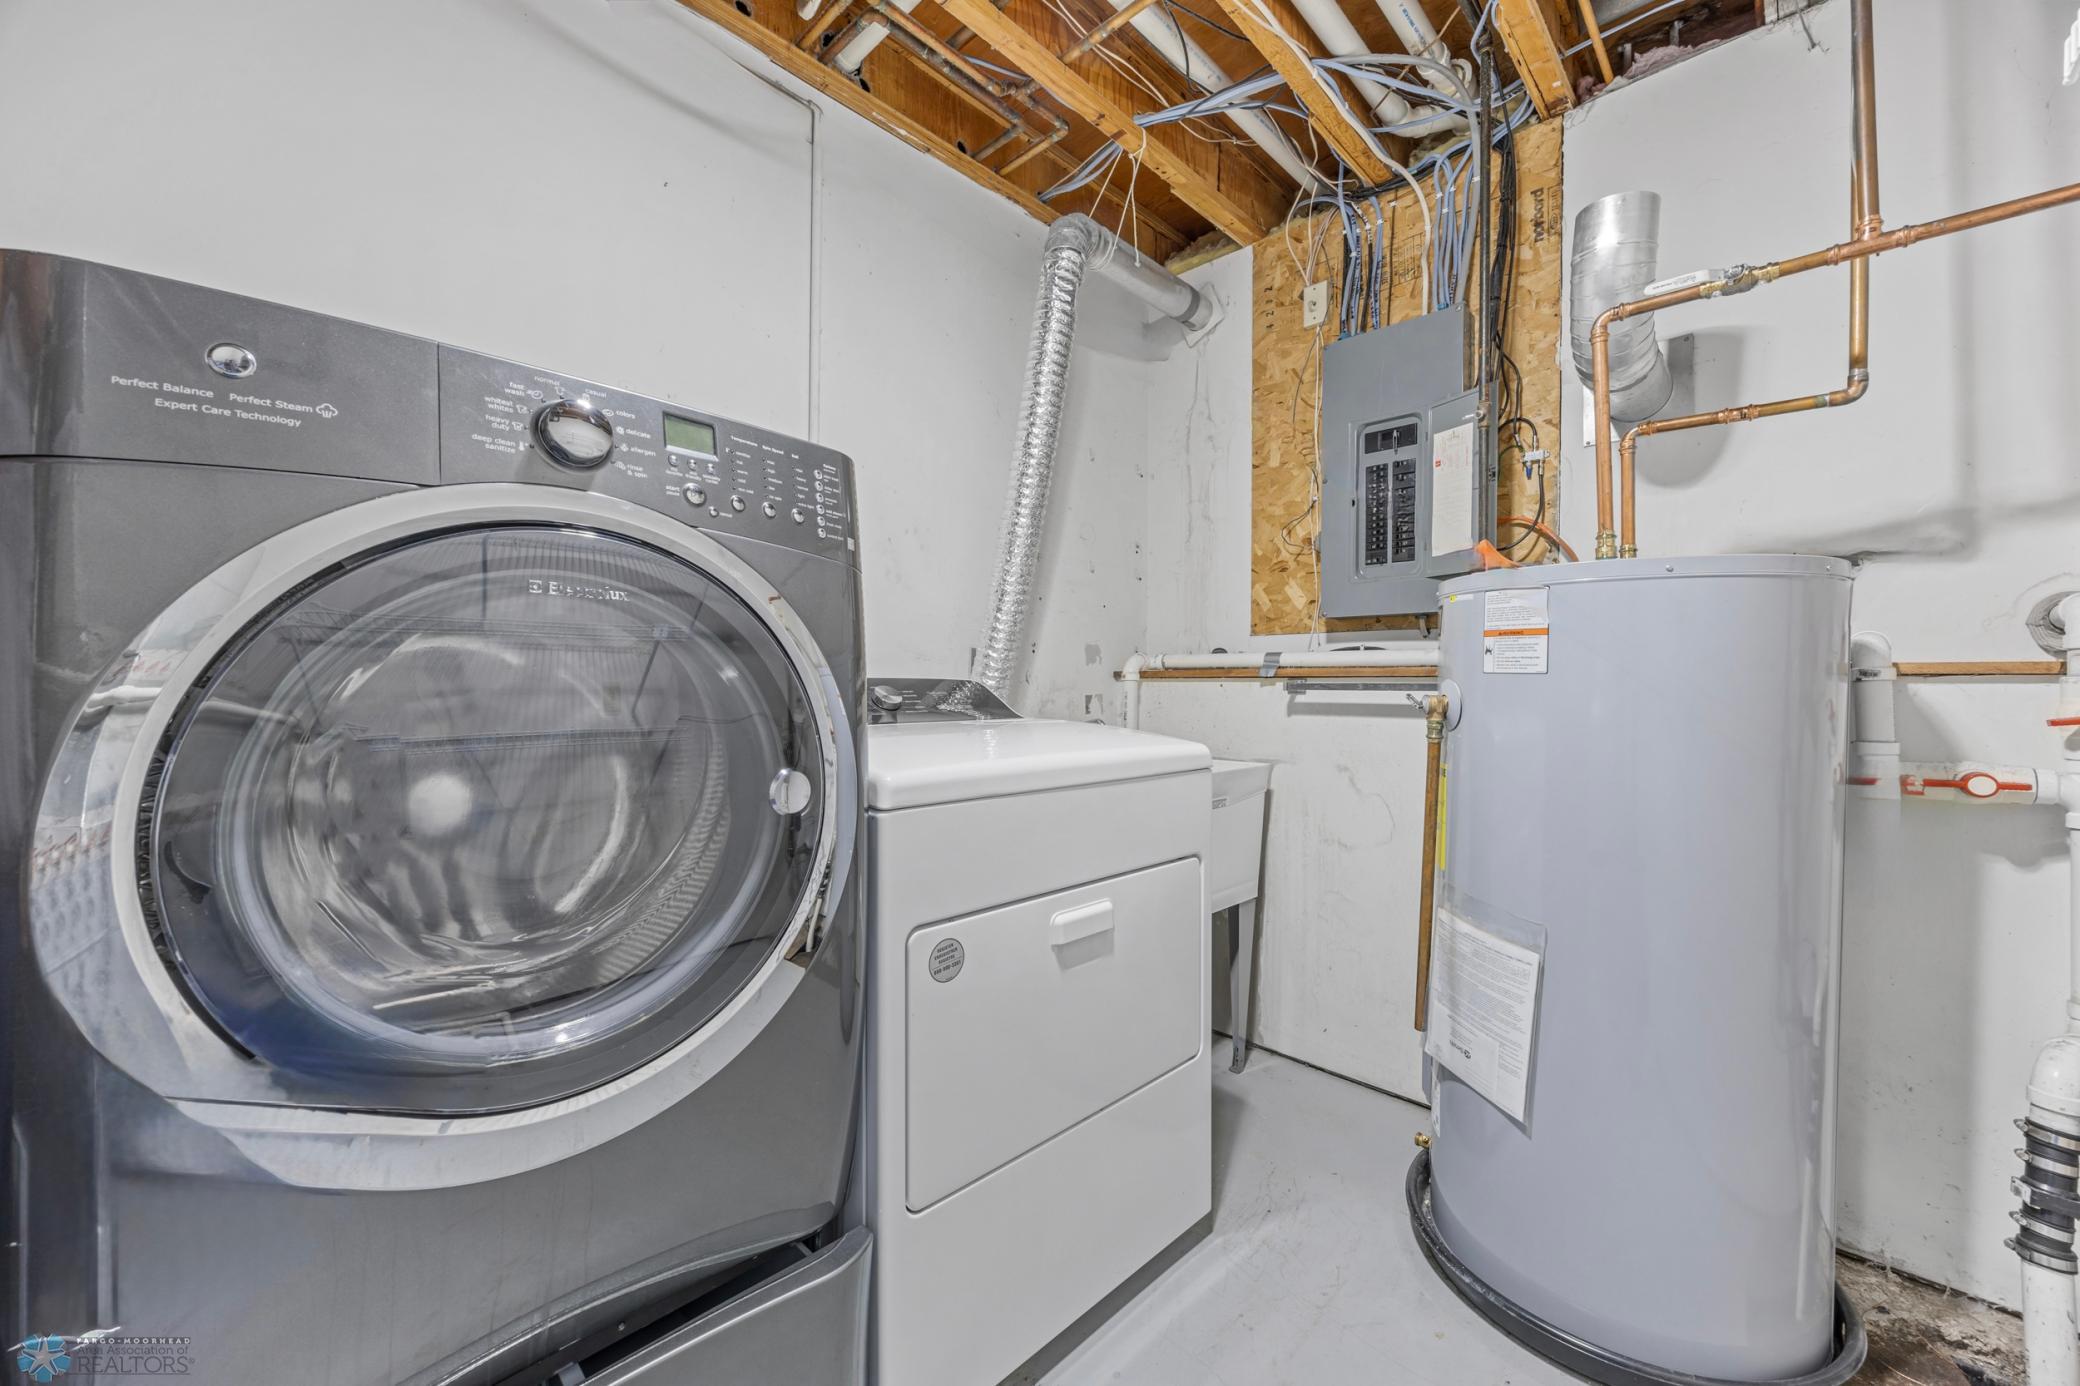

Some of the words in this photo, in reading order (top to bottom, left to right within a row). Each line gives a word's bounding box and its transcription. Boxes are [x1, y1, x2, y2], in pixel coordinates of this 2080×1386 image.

[534, 376, 560, 386] normal
[111, 375, 159, 390] Perfect
[163, 382, 214, 398] Balance
[229, 393, 272, 407] Perfect
[275, 400, 313, 413] Steam
[504, 388, 525, 396] wash
[584, 388, 607, 398] casual
[154, 397, 198, 411] Expert
[201, 404, 231, 417] Care
[234, 409, 302, 427] Technology
[488, 403, 514, 413] whites
[485, 414, 510, 425] heavy
[615, 410, 636, 419] colors
[491, 422, 510, 431] duty
[625, 428, 651, 439] delicate
[471, 433, 493, 443] deep
[494, 438, 516, 447] clean
[484, 443, 516, 454] sanitize
